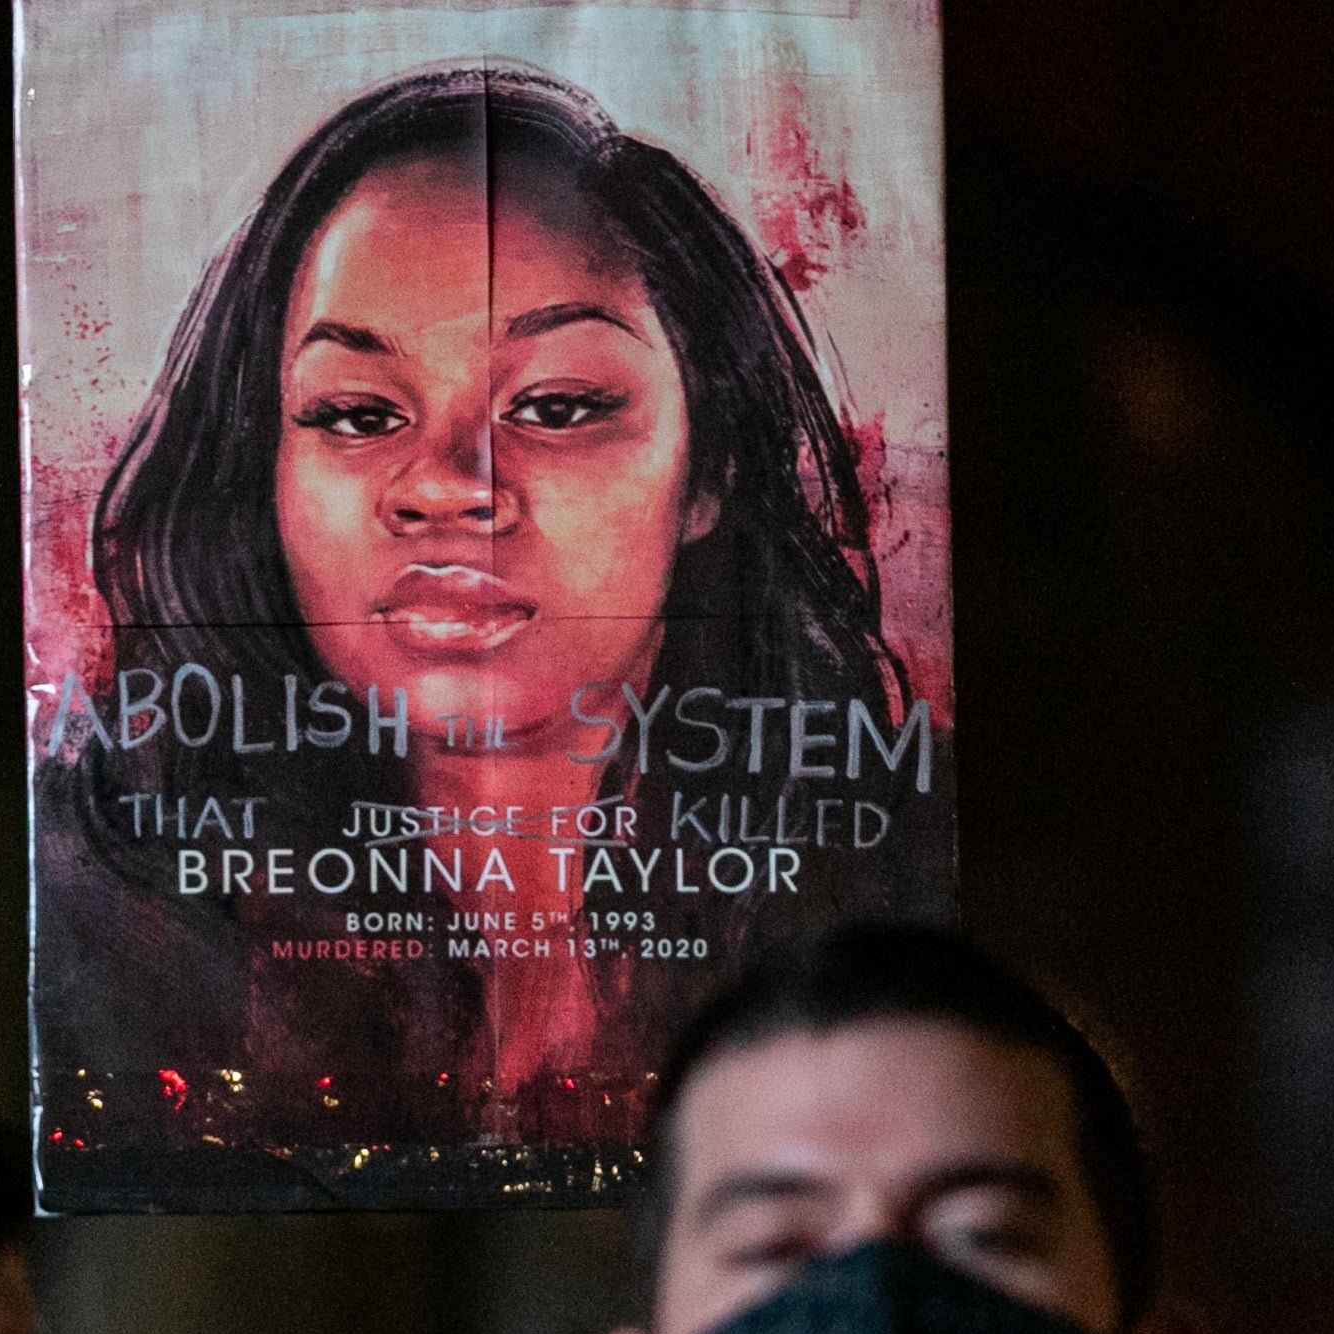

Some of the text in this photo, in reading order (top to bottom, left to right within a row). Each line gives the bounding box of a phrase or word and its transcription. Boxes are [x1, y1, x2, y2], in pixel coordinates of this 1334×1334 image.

[47, 663, 409, 758] ABOLISH
[568, 682, 932, 793] SYSTEM
[119, 794, 266, 840] THAT
[342, 806, 638, 838] JUSTICE FOR
[178, 847, 802, 895] BREONNA TAYLOR
[346, 911, 435, 932] BORN:
[447, 911, 517, 932] JUNE
[589, 911, 657, 932] 1993
[272, 939, 434, 960] MURDERED:
[448, 938, 551, 959] MARCH
[640, 938, 709, 959] 2020
